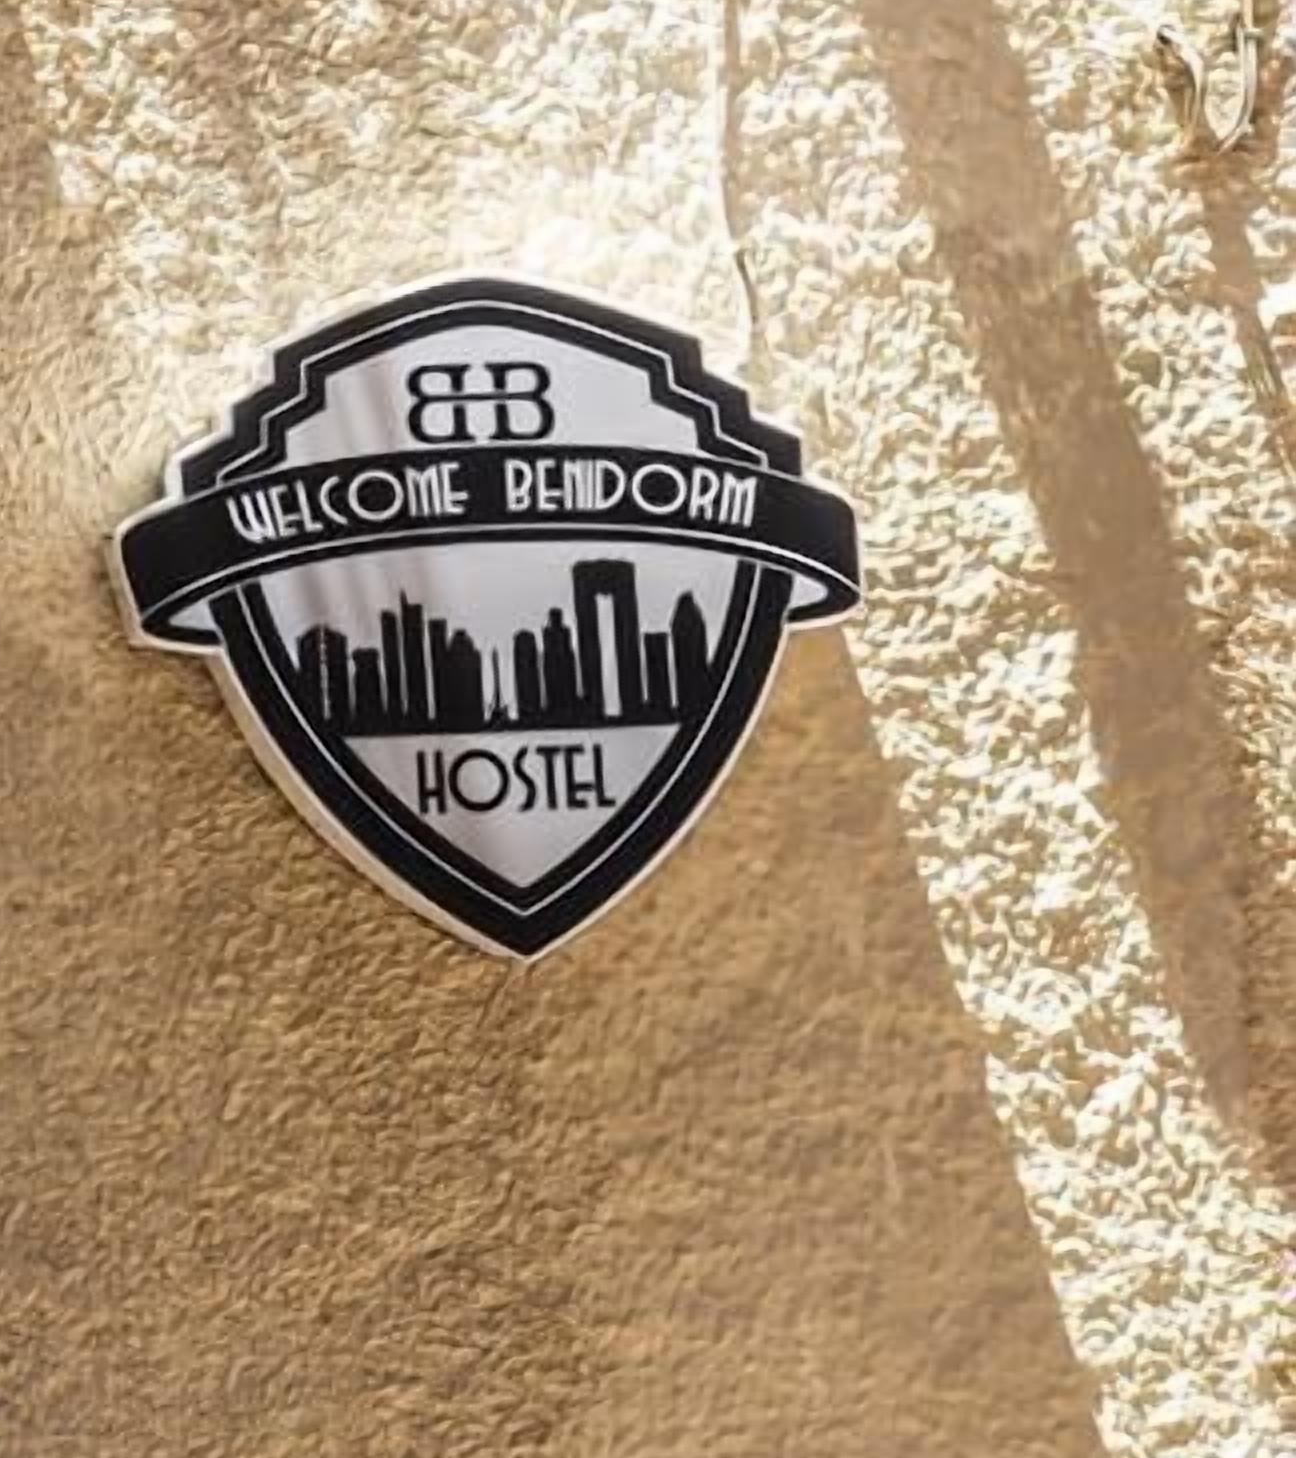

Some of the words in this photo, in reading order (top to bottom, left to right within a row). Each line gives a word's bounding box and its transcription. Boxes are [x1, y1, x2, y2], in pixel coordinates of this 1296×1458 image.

[226, 461, 469, 543] WELCOME
[504, 458, 758, 528] BENIDORM
[415, 743, 617, 816] HOSTEL
